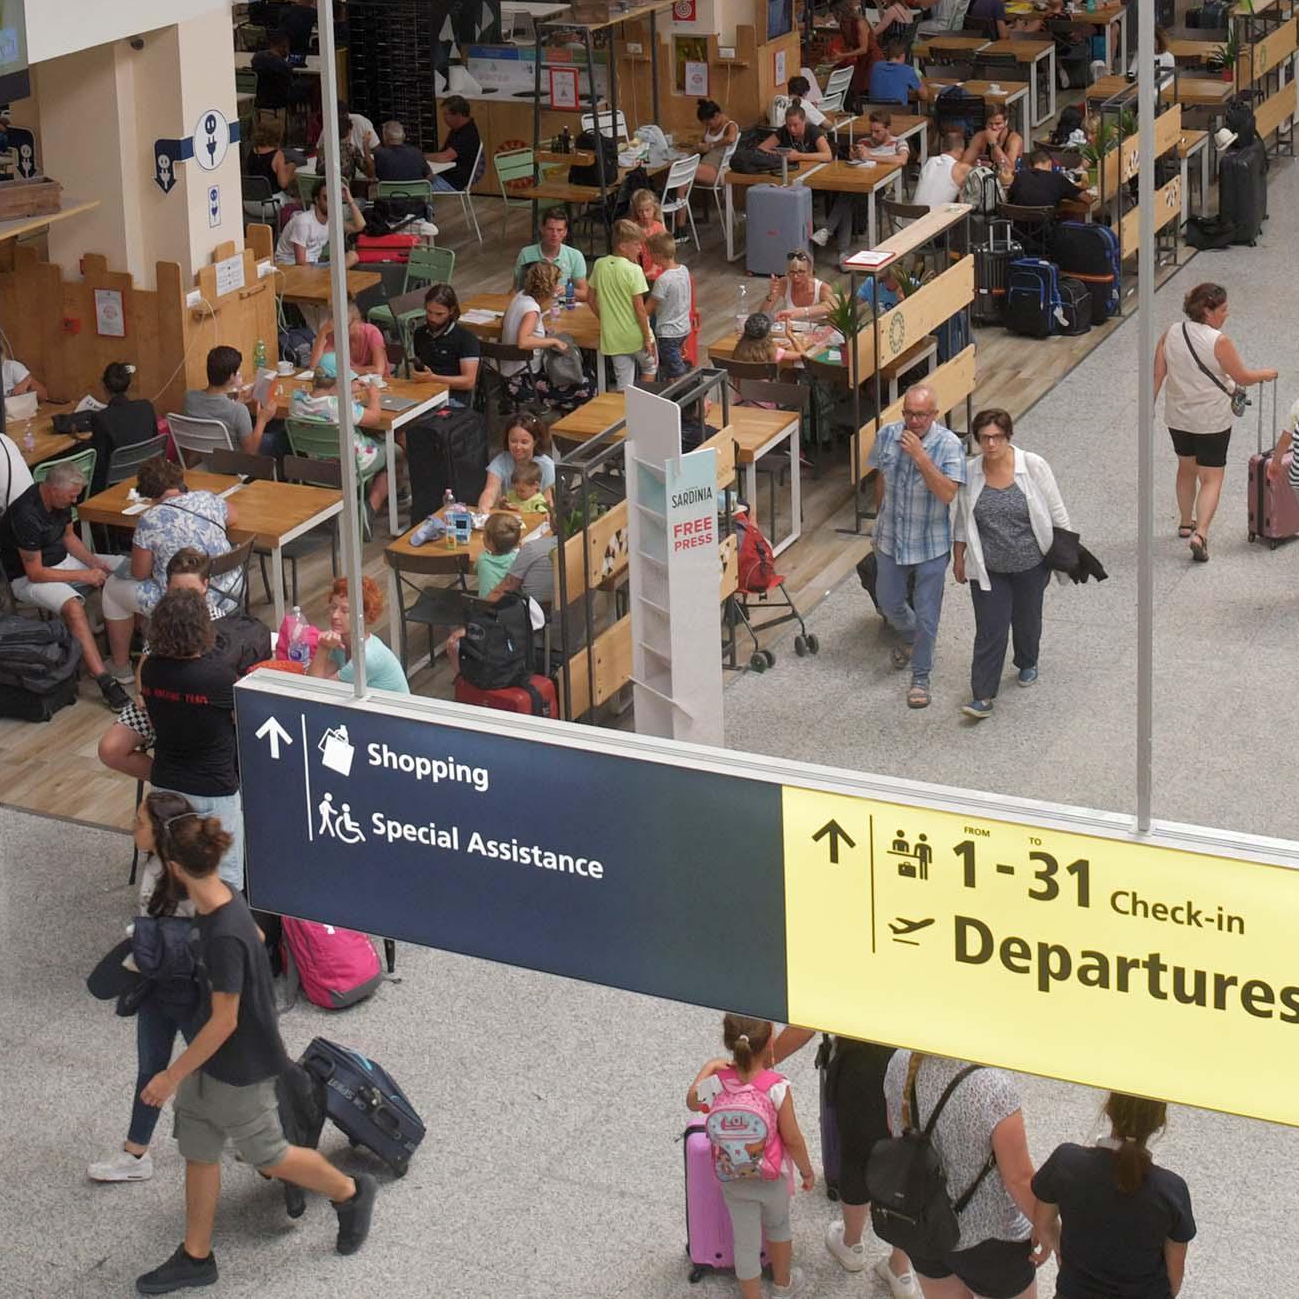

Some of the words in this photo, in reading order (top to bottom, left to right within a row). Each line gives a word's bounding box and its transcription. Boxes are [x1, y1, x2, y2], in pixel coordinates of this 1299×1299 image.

[671, 486, 713, 509] SARDINIA
[673, 516, 713, 538] FREE
[674, 533, 713, 552] PRESS
[367, 742, 490, 792] Shopping
[963, 825, 991, 839] FROM
[1029, 836, 1043, 847] TO
[372, 812, 459, 853] Special
[467, 831, 604, 880] Assistance
[1110, 889, 1246, 935] Check-in
